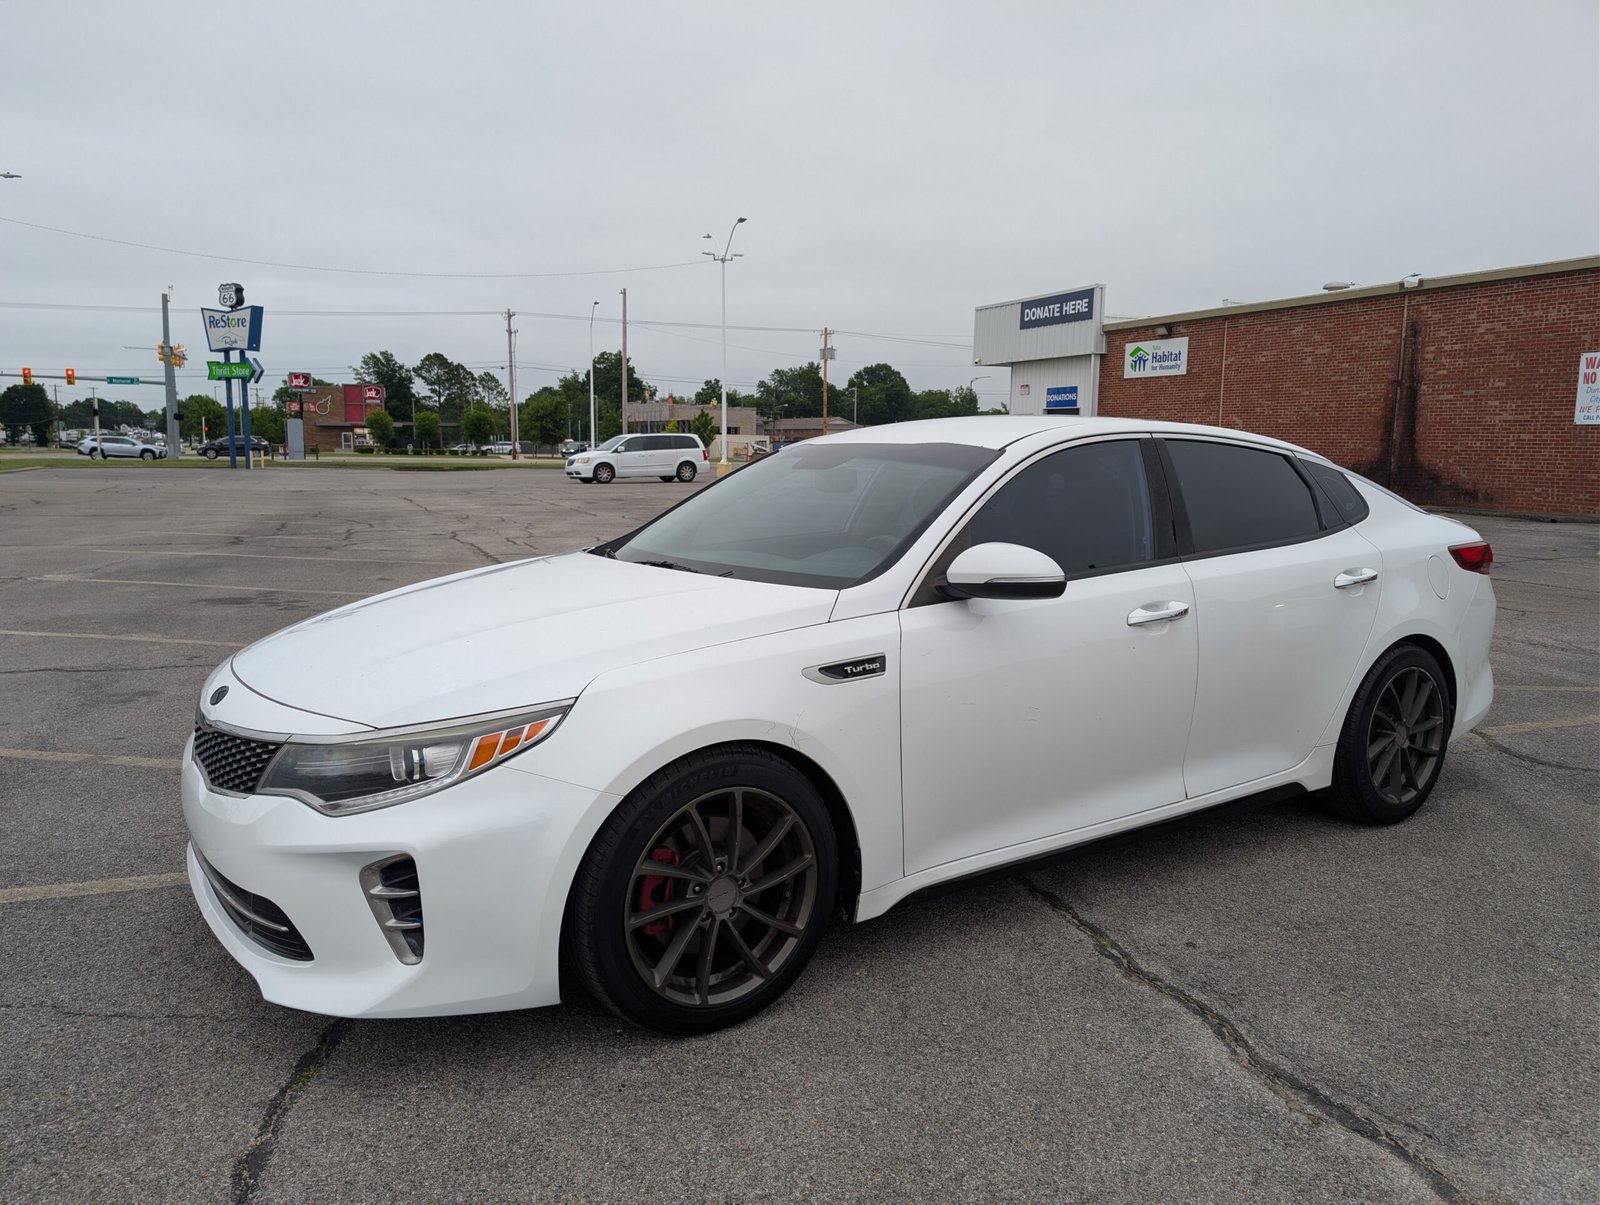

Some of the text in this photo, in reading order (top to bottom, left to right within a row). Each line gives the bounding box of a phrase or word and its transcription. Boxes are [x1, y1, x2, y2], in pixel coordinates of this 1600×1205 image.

[222, 293, 234, 304] 66
[1024, 299, 1089, 321] DONATE HERE
[209, 315, 246, 328] ReStore
[1151, 350, 1182, 363] Habitat
[212, 366, 250, 375] Thrift Store
[1158, 363, 1181, 371] Humanity
[1583, 372, 1597, 384] NO
[1047, 393, 1077, 402] DONATIONS
[844, 663, 880, 674] Turbo
